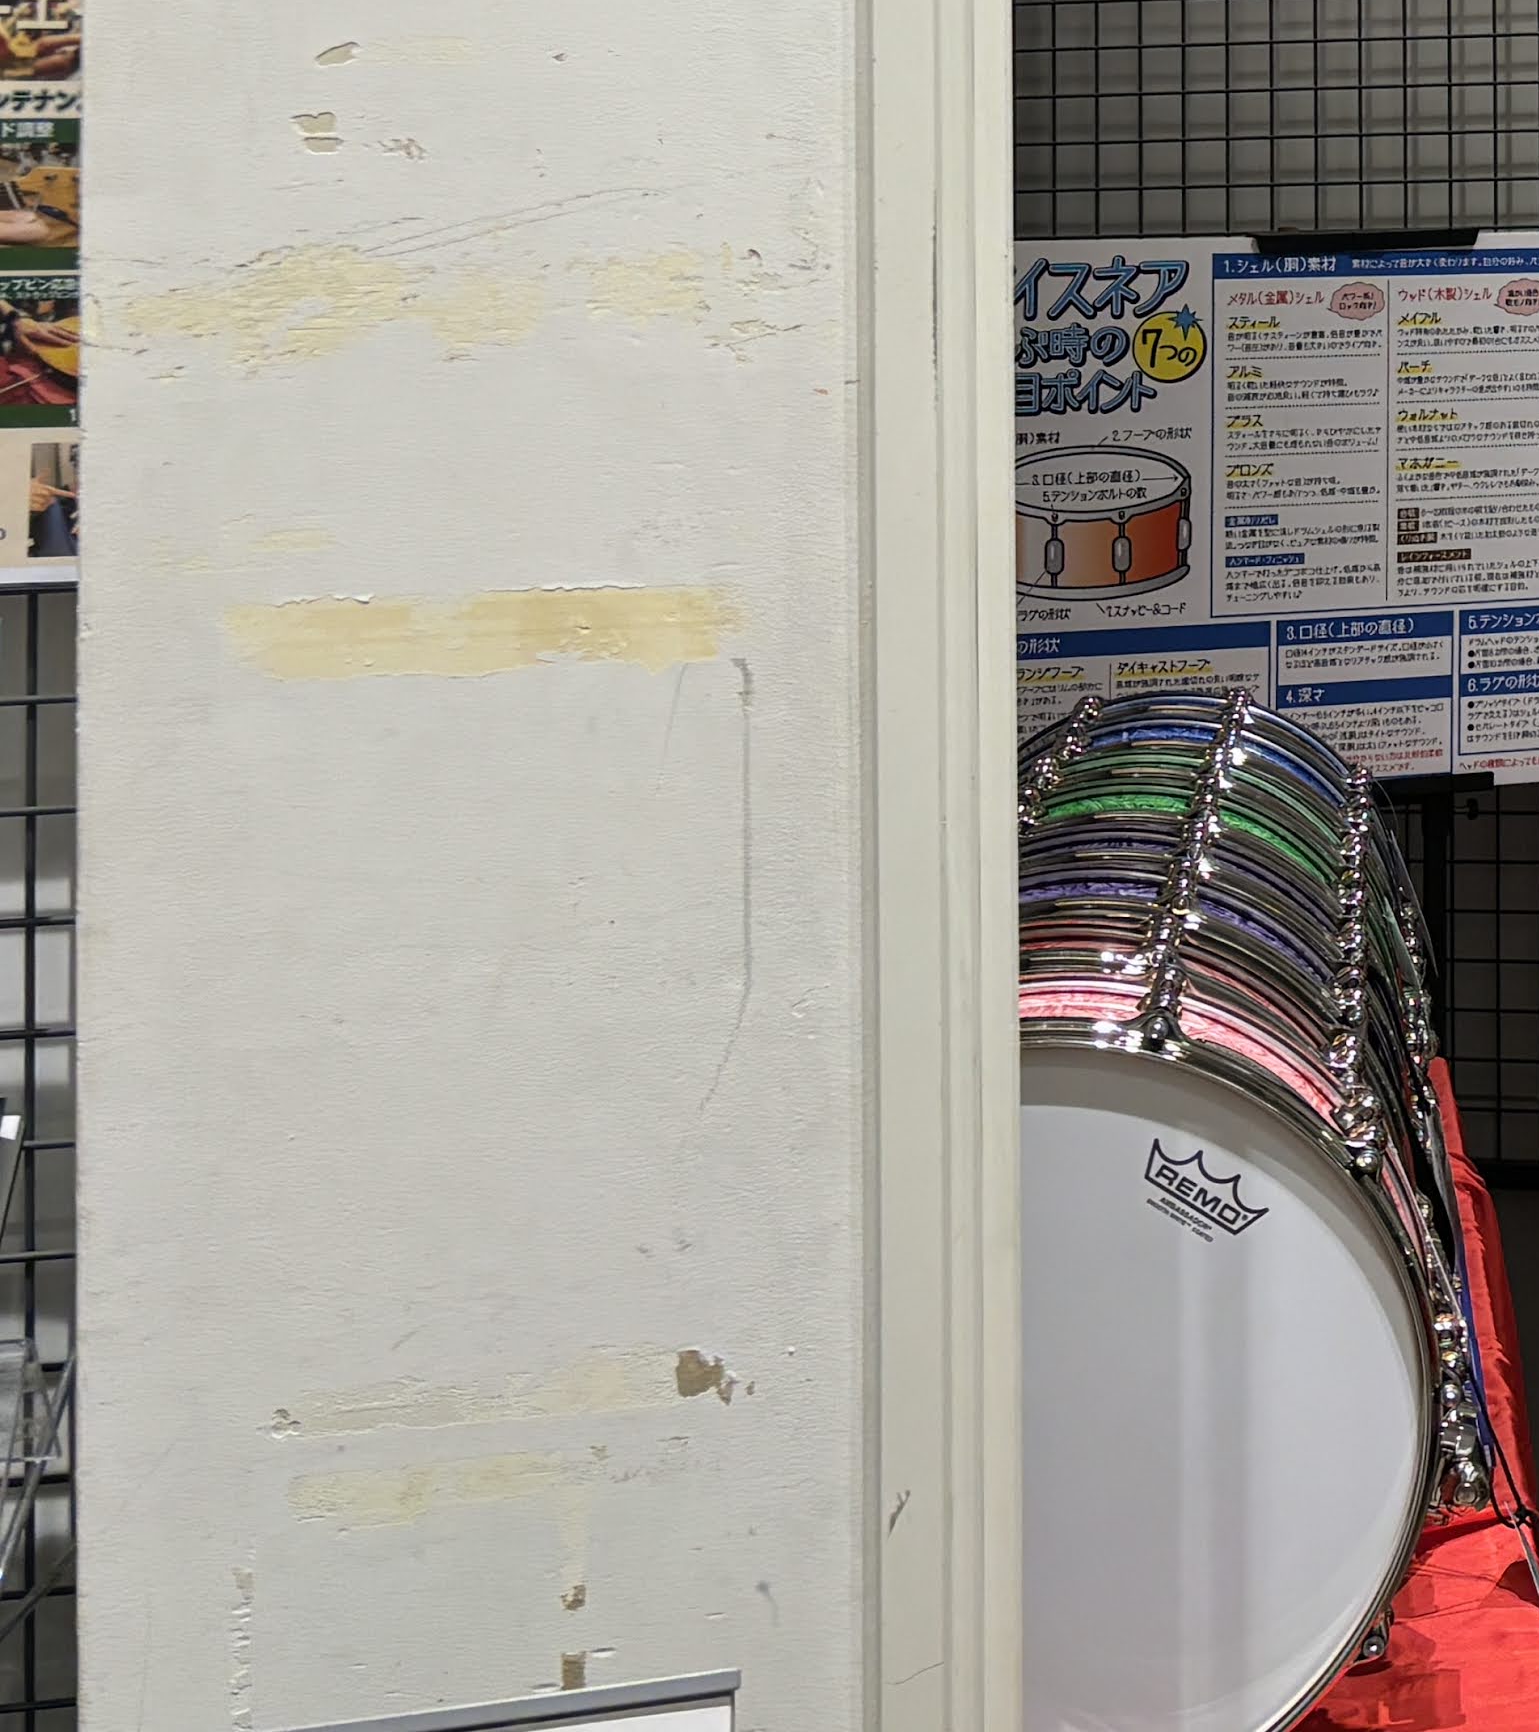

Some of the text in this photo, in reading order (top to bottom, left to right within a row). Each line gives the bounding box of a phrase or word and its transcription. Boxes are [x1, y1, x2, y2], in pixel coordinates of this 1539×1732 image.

[1014, 254, 1189, 320] イスネア
[1227, 315, 1280, 330] スティール
[1398, 311, 1441, 326] メイプル
[1017, 322, 1197, 369] ぶ時の 7つの
[1226, 365, 1263, 379] アルミ
[1397, 359, 1431, 374] バーチ
[1226, 413, 1264, 428] ブラス
[1397, 408, 1458, 422] ウォルナット
[1226, 462, 1274, 478] ブロンズ
[1397, 456, 1459, 470] マホガニー
[1117, 659, 1212, 676] ダイキャストフープ
[1155, 1164, 1241, 1225] REMO
